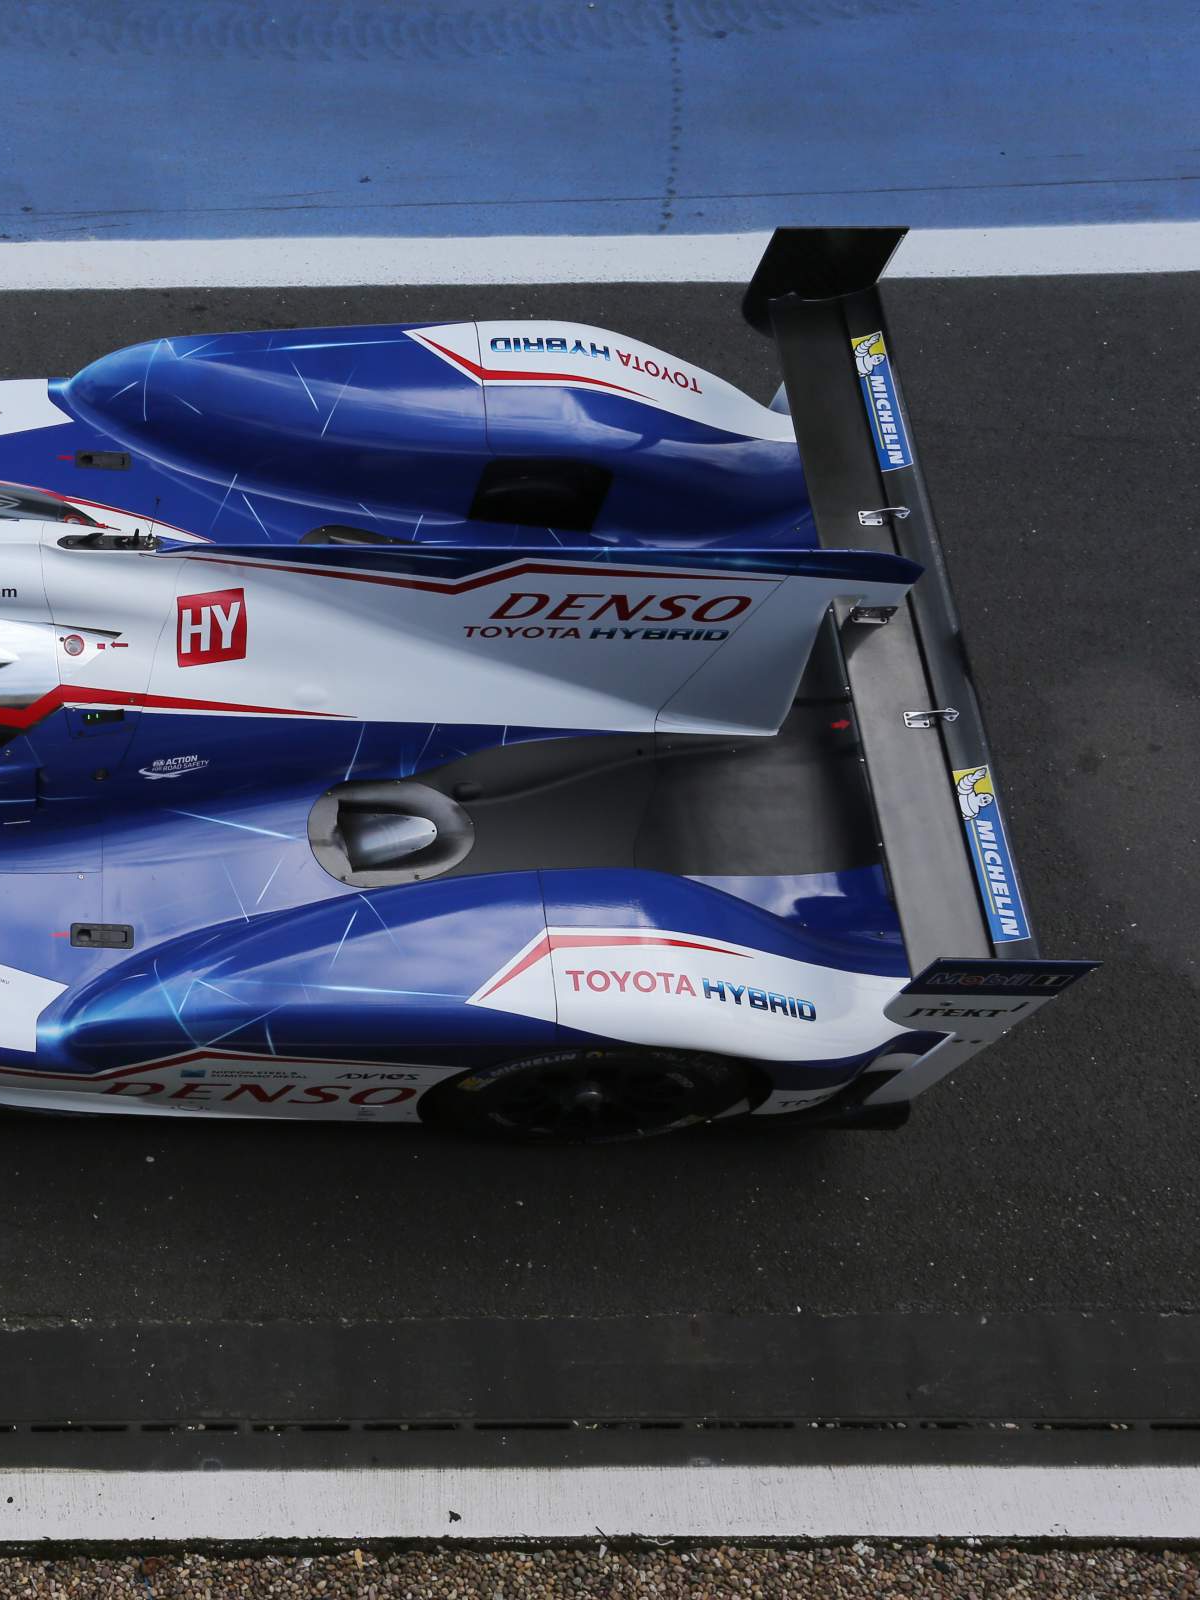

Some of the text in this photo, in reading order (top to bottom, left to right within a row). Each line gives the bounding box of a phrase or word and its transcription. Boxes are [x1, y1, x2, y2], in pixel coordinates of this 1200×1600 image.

[490, 337, 703, 395] TOYOTA HYBRID
[870, 375, 905, 464] MICHELIN
[489, 593, 752, 622] DENSO
[181, 602, 240, 654] HY
[463, 626, 730, 641] TOYOTA HYBRID
[166, 755, 198, 766] ACTION
[184, 760, 209, 769] SAFETY
[976, 819, 1020, 937] MICHELIN
[927, 973, 1031, 986] Mobil
[565, 970, 817, 1021] TOYOTA HYBRID
[905, 1008, 1009, 1018] JTEKT
[491, 1053, 576, 1078] MICHELIN
[100, 1082, 417, 1105] DENSO
